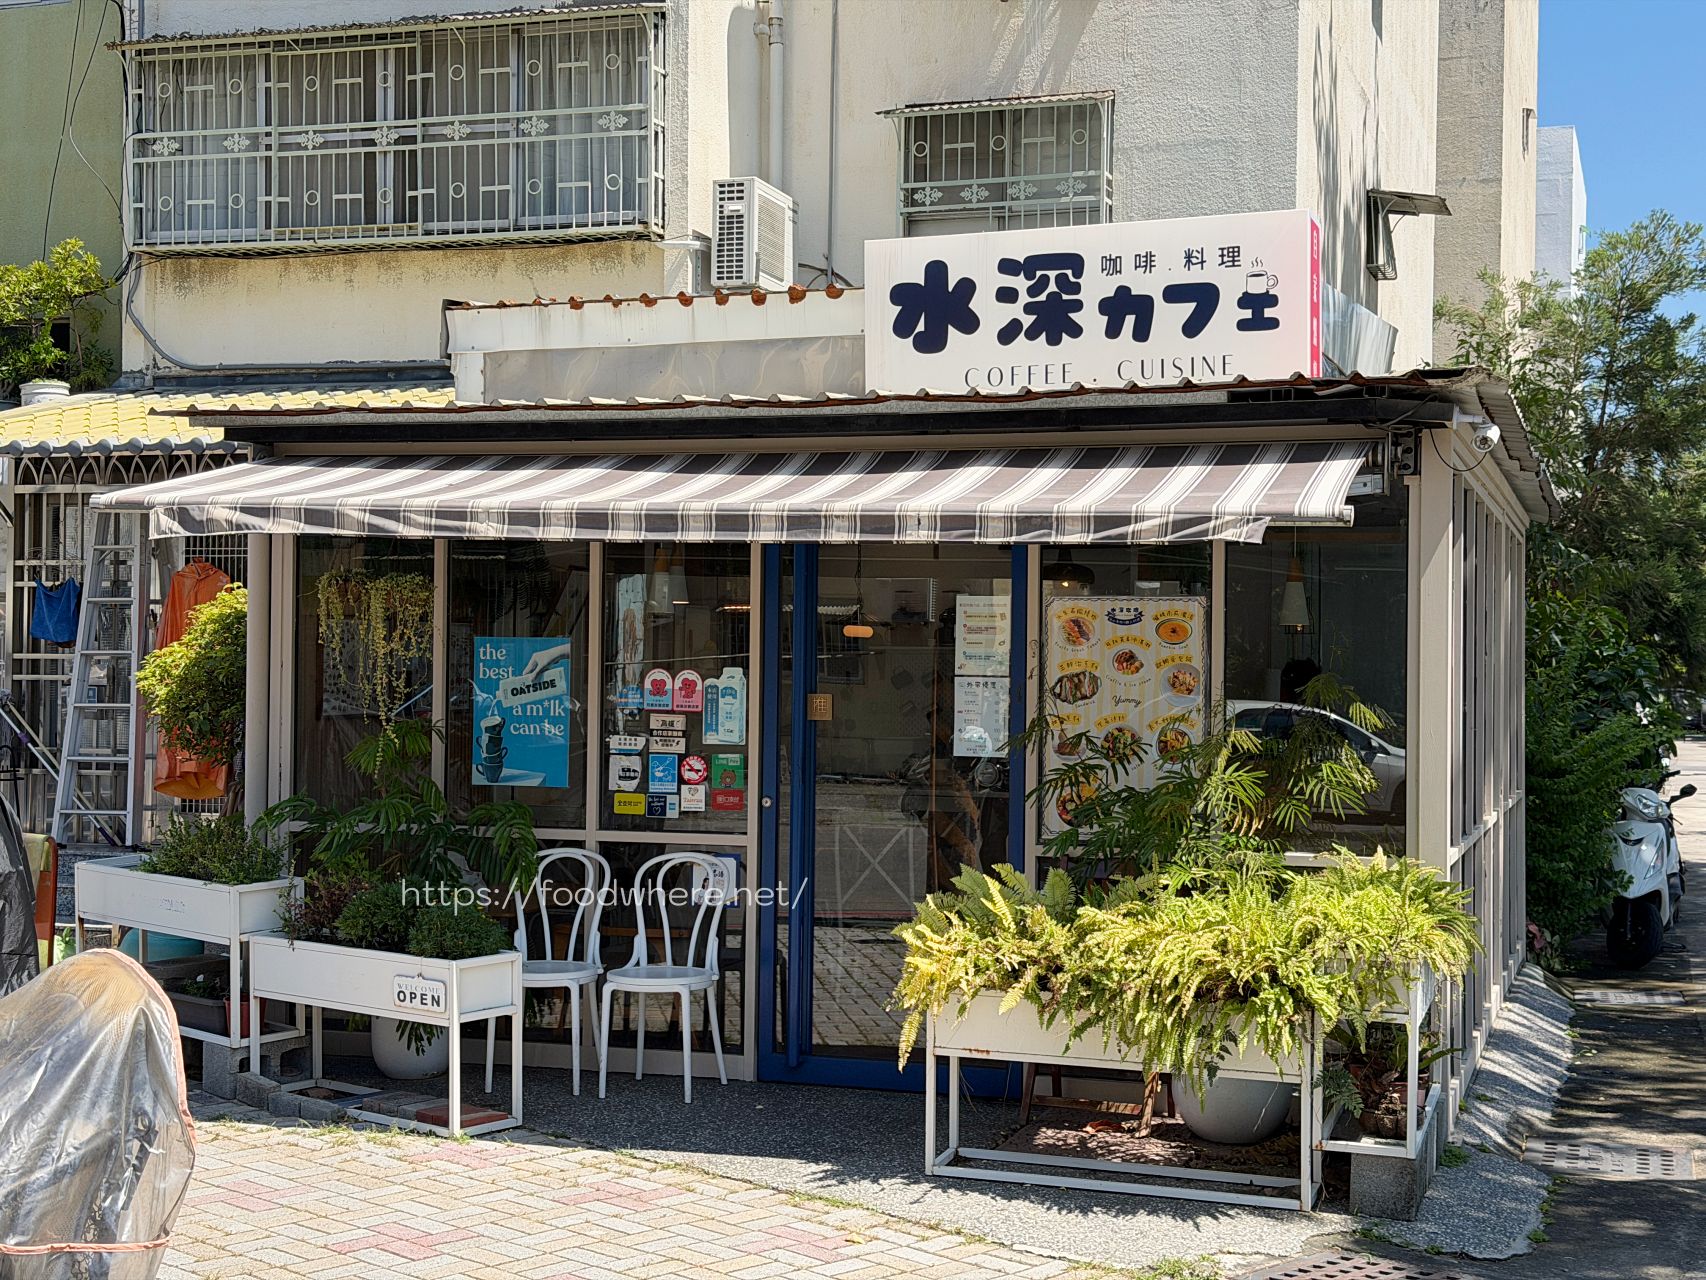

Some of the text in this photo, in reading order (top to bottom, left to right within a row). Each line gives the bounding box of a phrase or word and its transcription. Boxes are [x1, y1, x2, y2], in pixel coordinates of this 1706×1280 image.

[964, 363, 1073, 388] COFFEE
[1117, 354, 1235, 381] CUISINE
[479, 643, 507, 660] the
[479, 663, 515, 680] best
[510, 679, 557, 697] OATSIDE
[513, 704, 523, 716] a
[1111, 694, 1143, 709] Yummy
[510, 723, 540, 736] can
[396, 981, 442, 996] WELCOME
[396, 989, 442, 1009] OPEN
